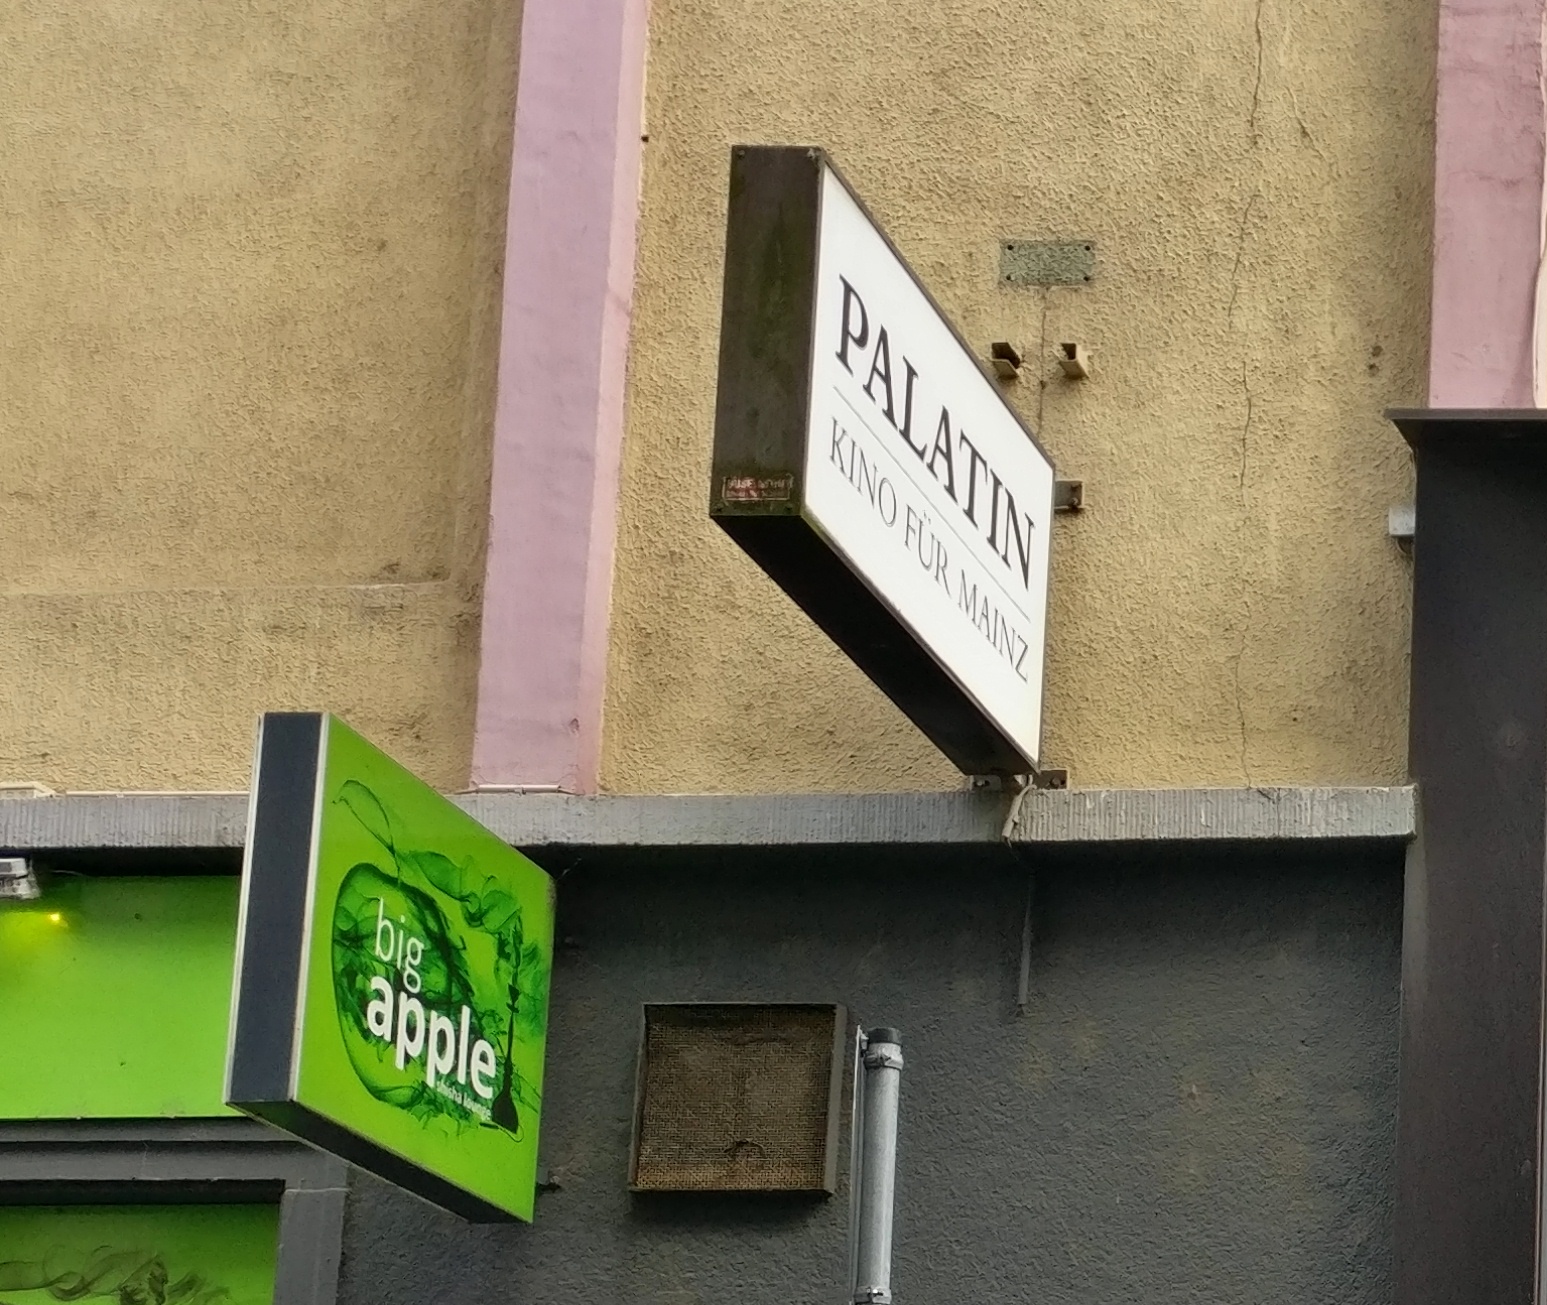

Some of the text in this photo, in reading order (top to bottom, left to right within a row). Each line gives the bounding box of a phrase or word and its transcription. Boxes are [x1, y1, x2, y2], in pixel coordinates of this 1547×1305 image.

[834, 273, 1036, 592] PALATIN
[830, 419, 1029, 684] KINO FÜR MAINZ
[367, 976, 496, 1099] apple
[375, 896, 424, 994] big
